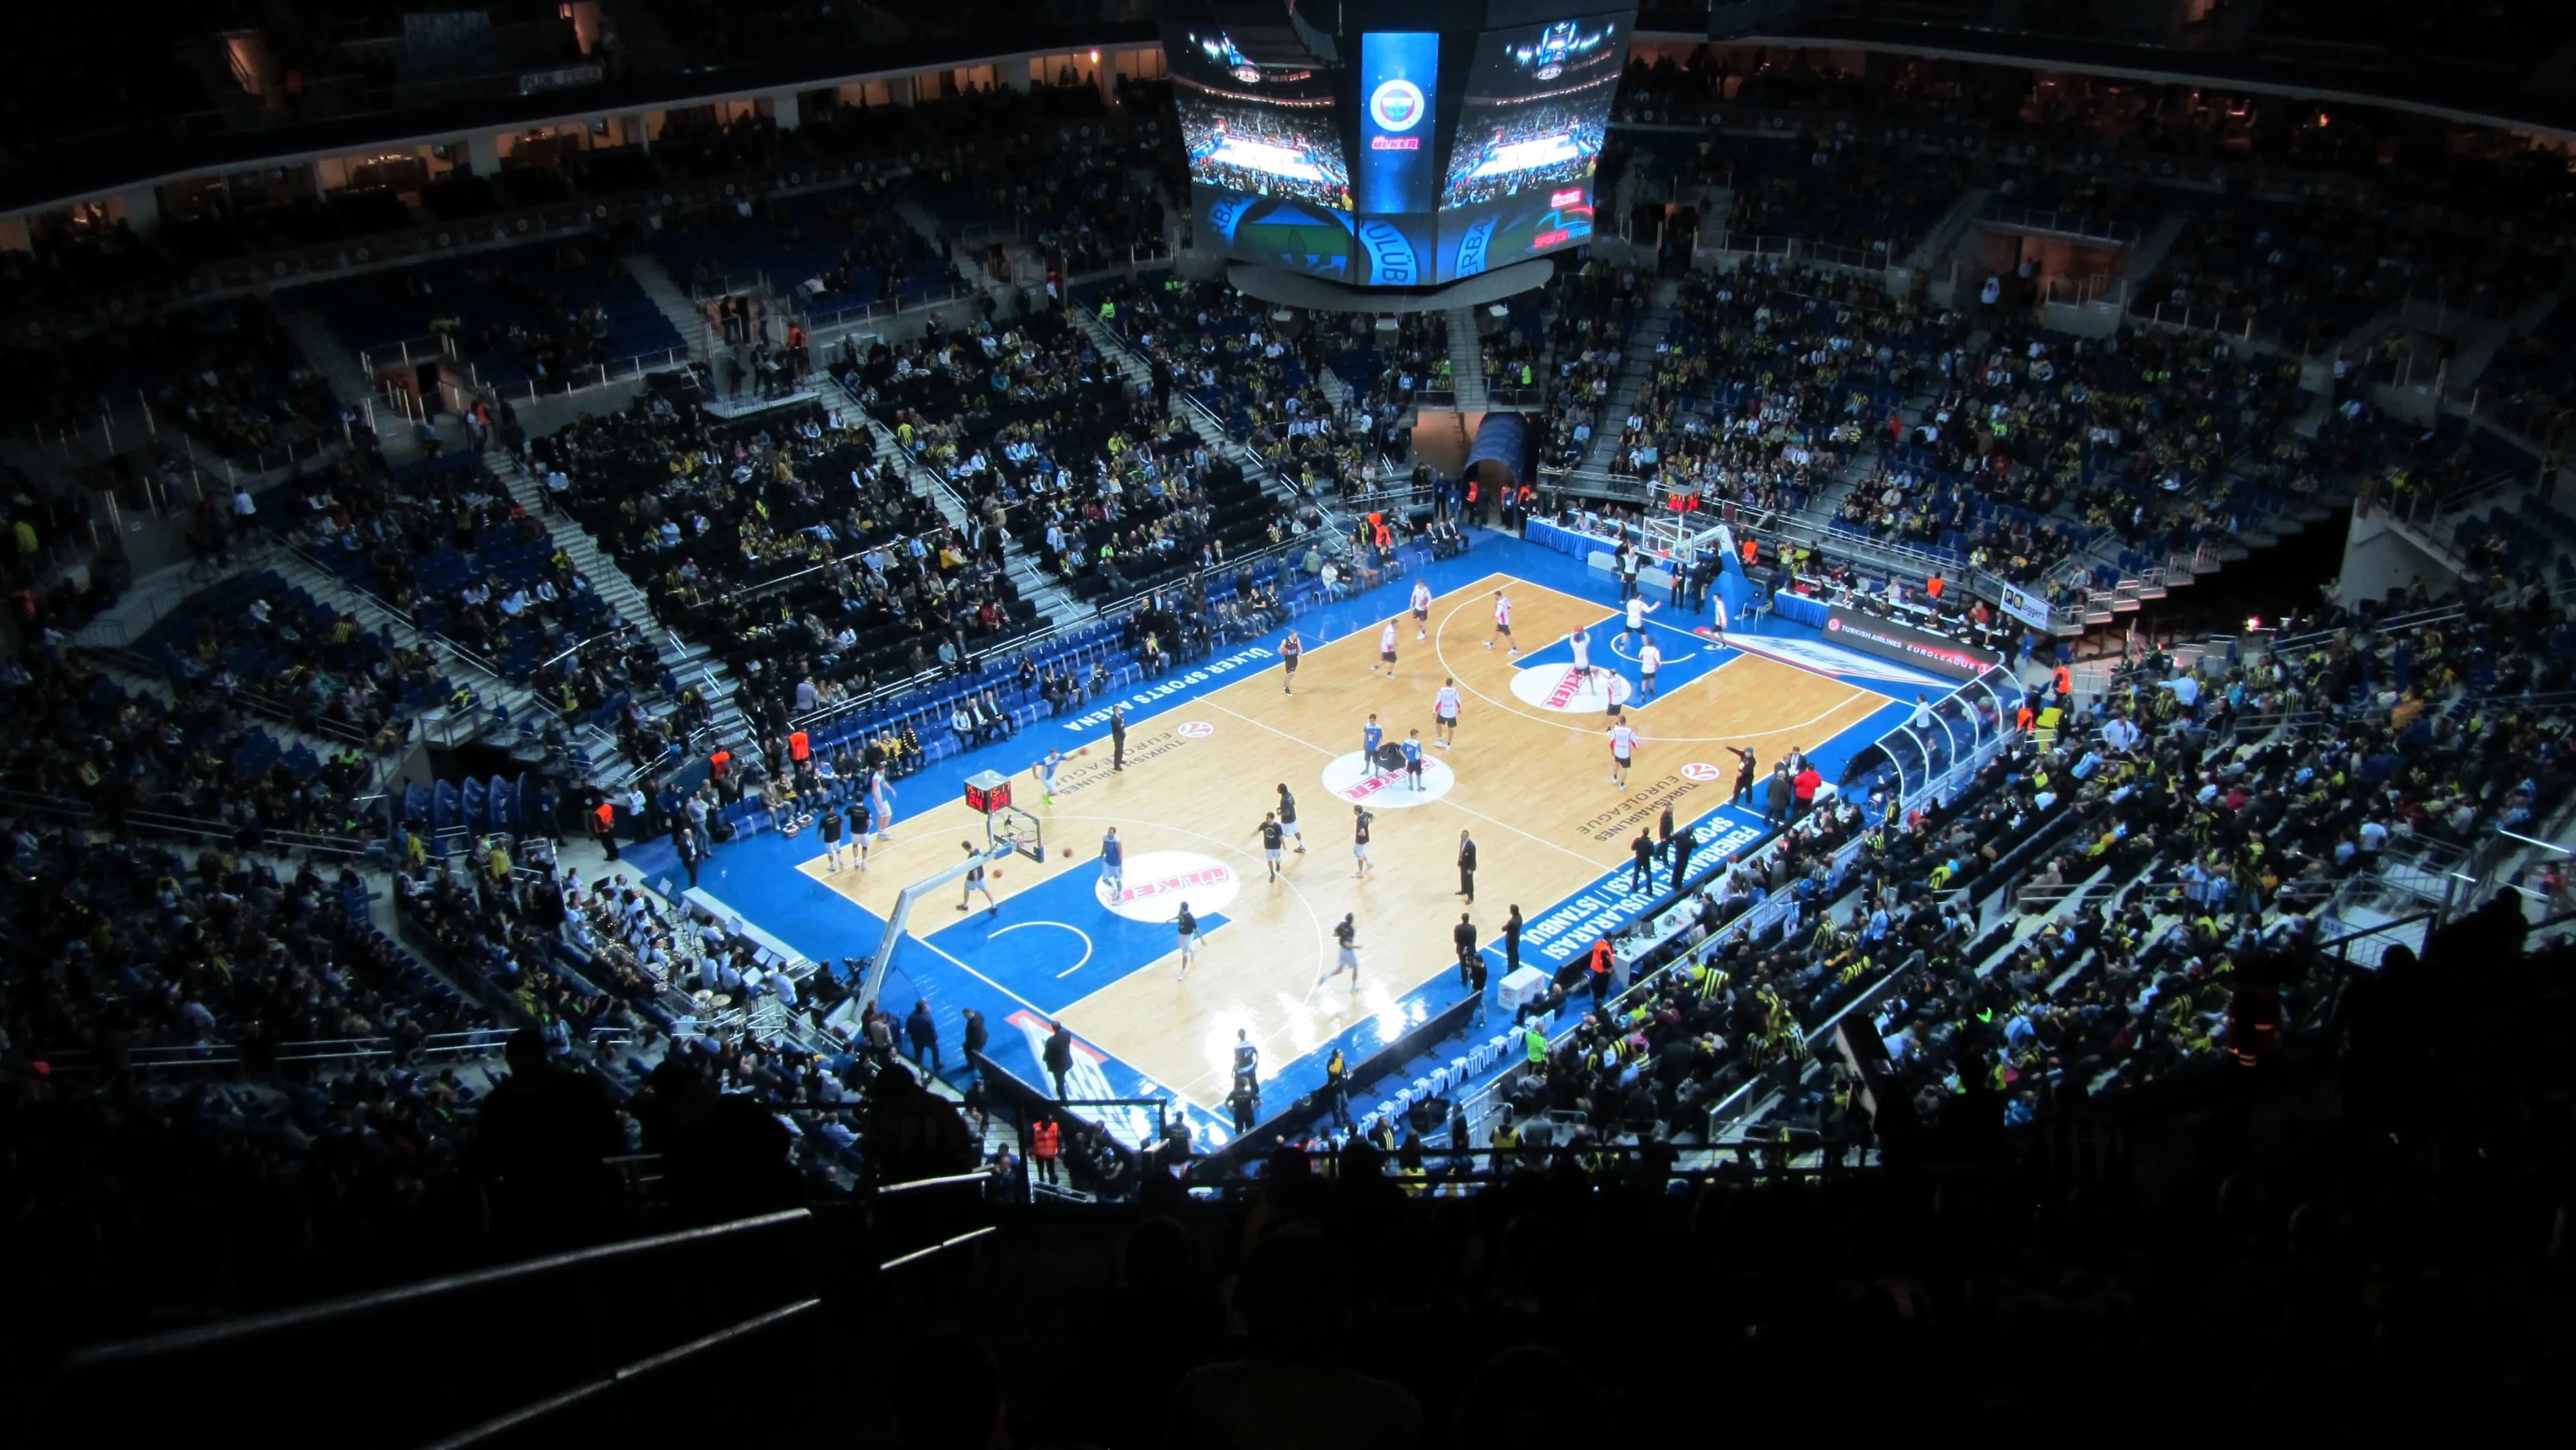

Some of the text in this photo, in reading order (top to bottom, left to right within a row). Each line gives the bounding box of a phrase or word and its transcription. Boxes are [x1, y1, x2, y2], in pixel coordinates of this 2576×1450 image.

[1204, 647, 1273, 673] ÜLKER
[1841, 625, 1976, 670] TURKISH AIRLINES EUROLEAGUE
[1133, 671, 1210, 704] SPORTS
[1056, 732, 1172, 786] EUROEAGU
[1059, 740, 1186, 795] TURKISH IRLINES
[968, 793, 984, 811] 24
[991, 793, 1008, 811] 24
[1577, 775, 1679, 834] EUROLEAGUE
